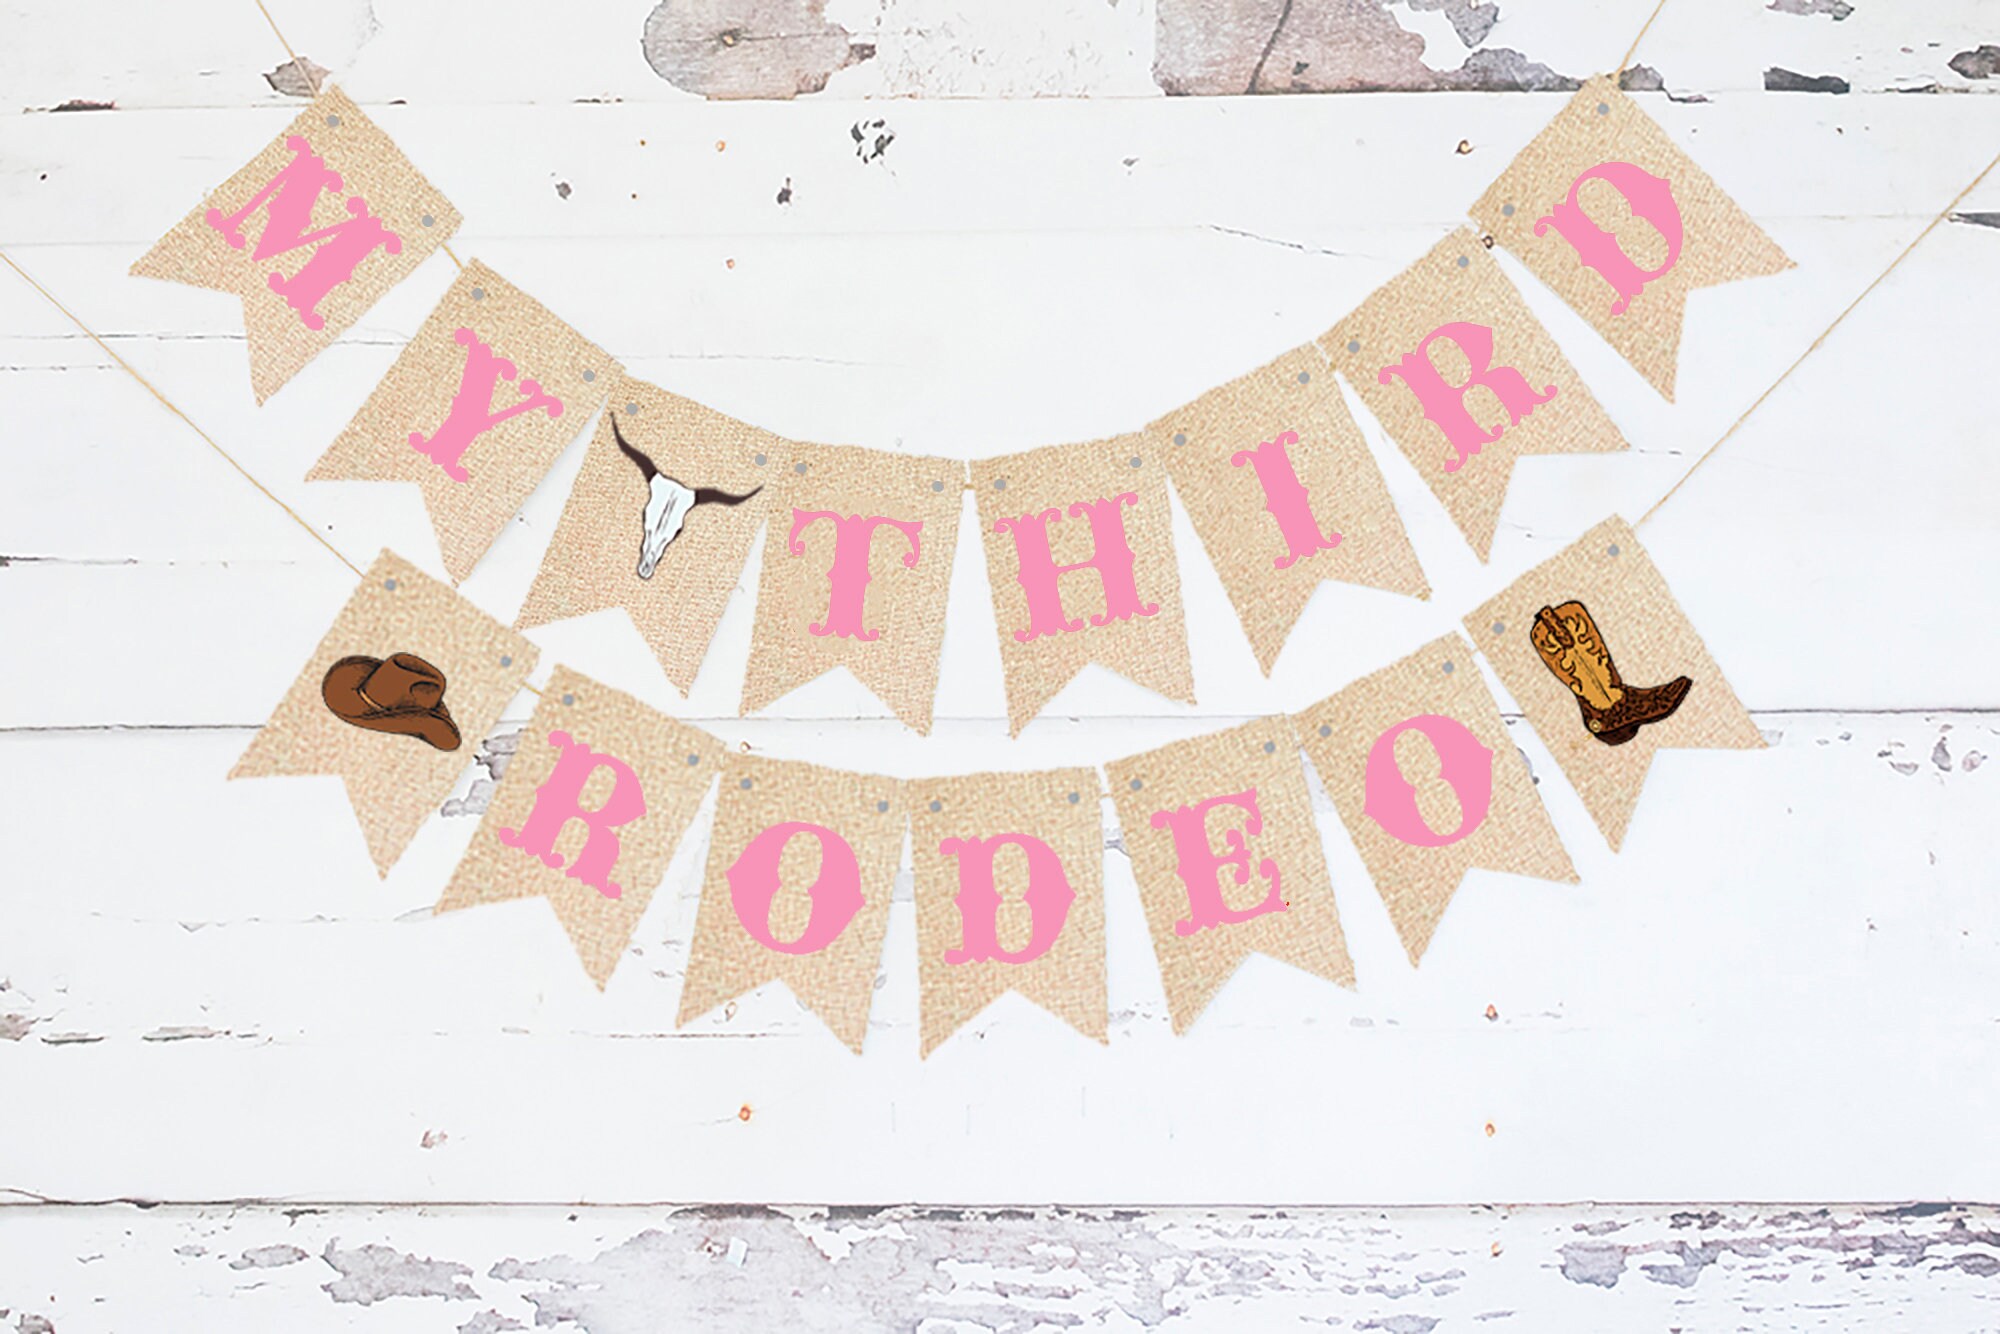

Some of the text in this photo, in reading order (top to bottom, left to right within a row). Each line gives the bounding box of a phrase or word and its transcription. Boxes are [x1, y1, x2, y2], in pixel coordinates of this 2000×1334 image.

[206, 135, 1683, 642] MY THIRD
[499, 713, 1494, 965] RODEO
